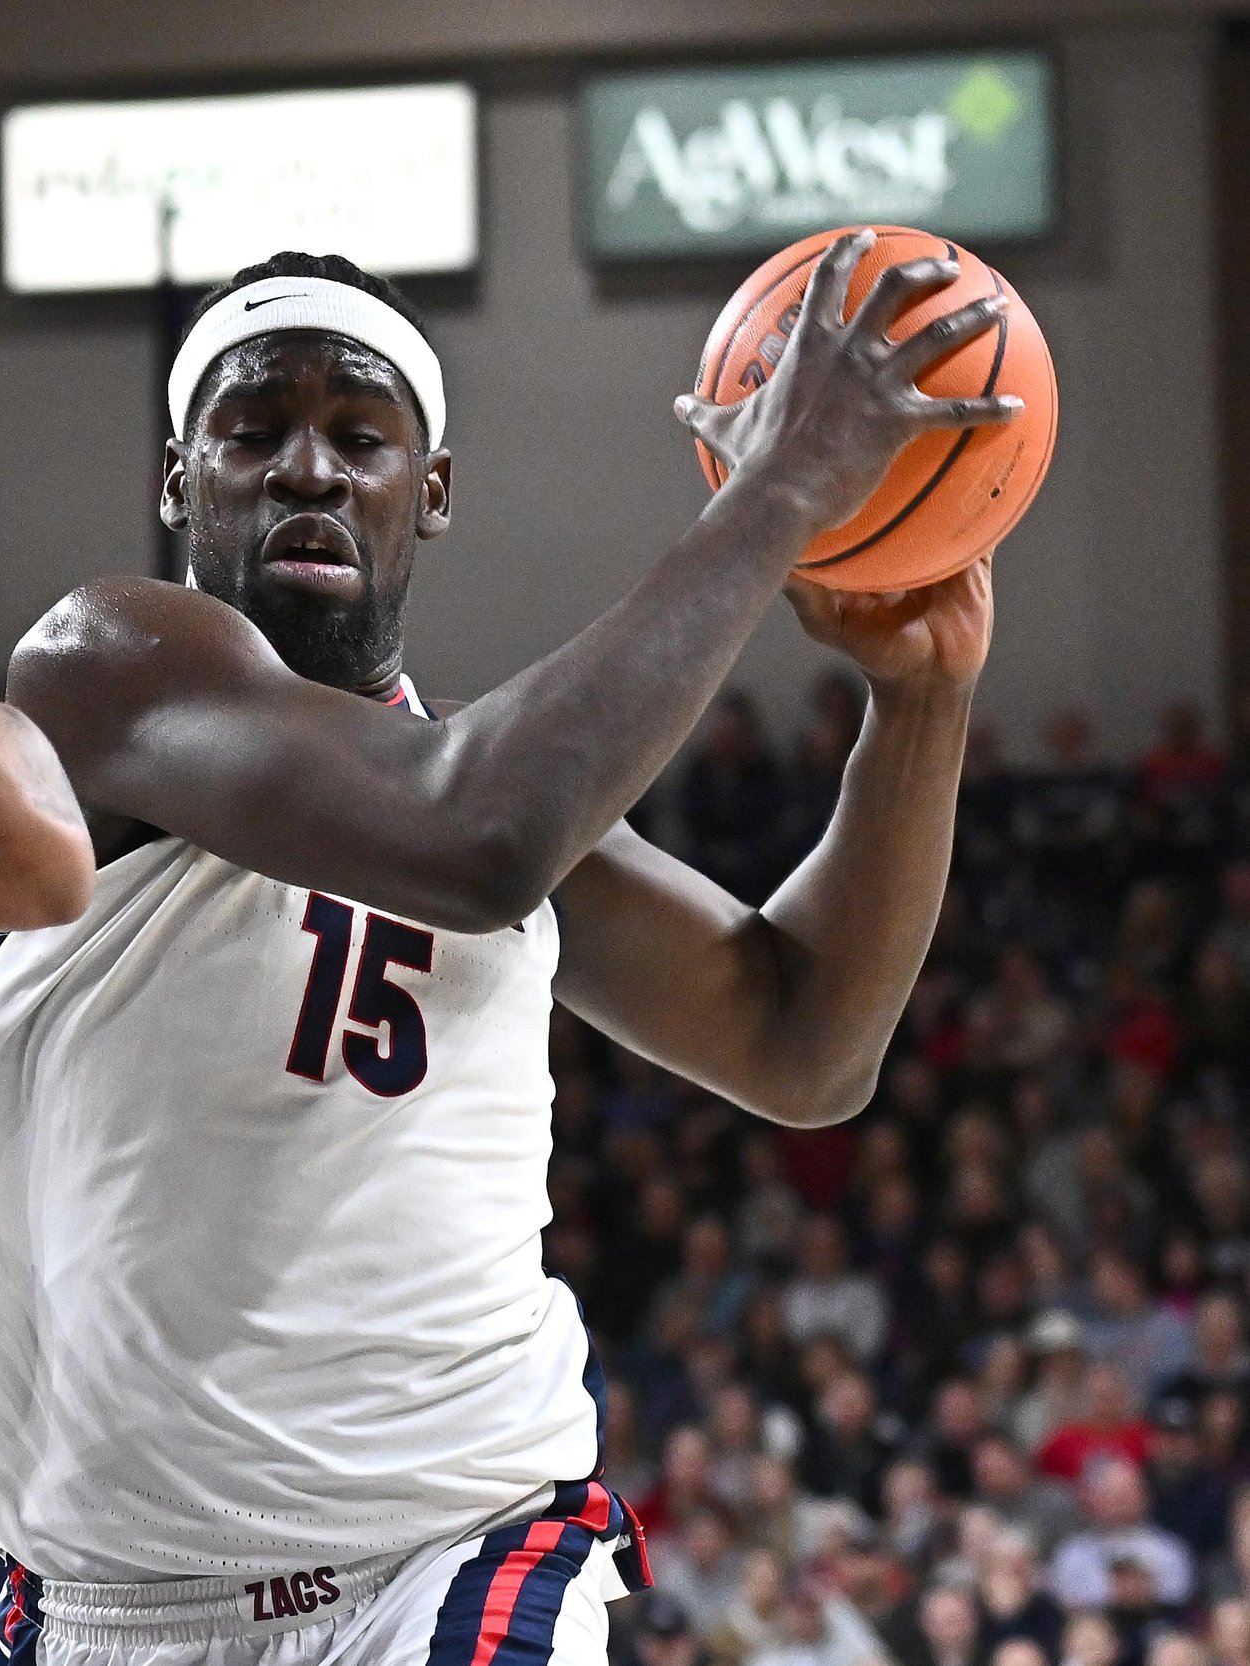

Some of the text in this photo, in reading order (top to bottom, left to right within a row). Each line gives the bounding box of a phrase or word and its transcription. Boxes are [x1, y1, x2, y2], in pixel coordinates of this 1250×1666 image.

[607, 96, 954, 231] AgWest
[285, 890, 434, 1097] 15
[244, 1566, 340, 1621] ZAGS
